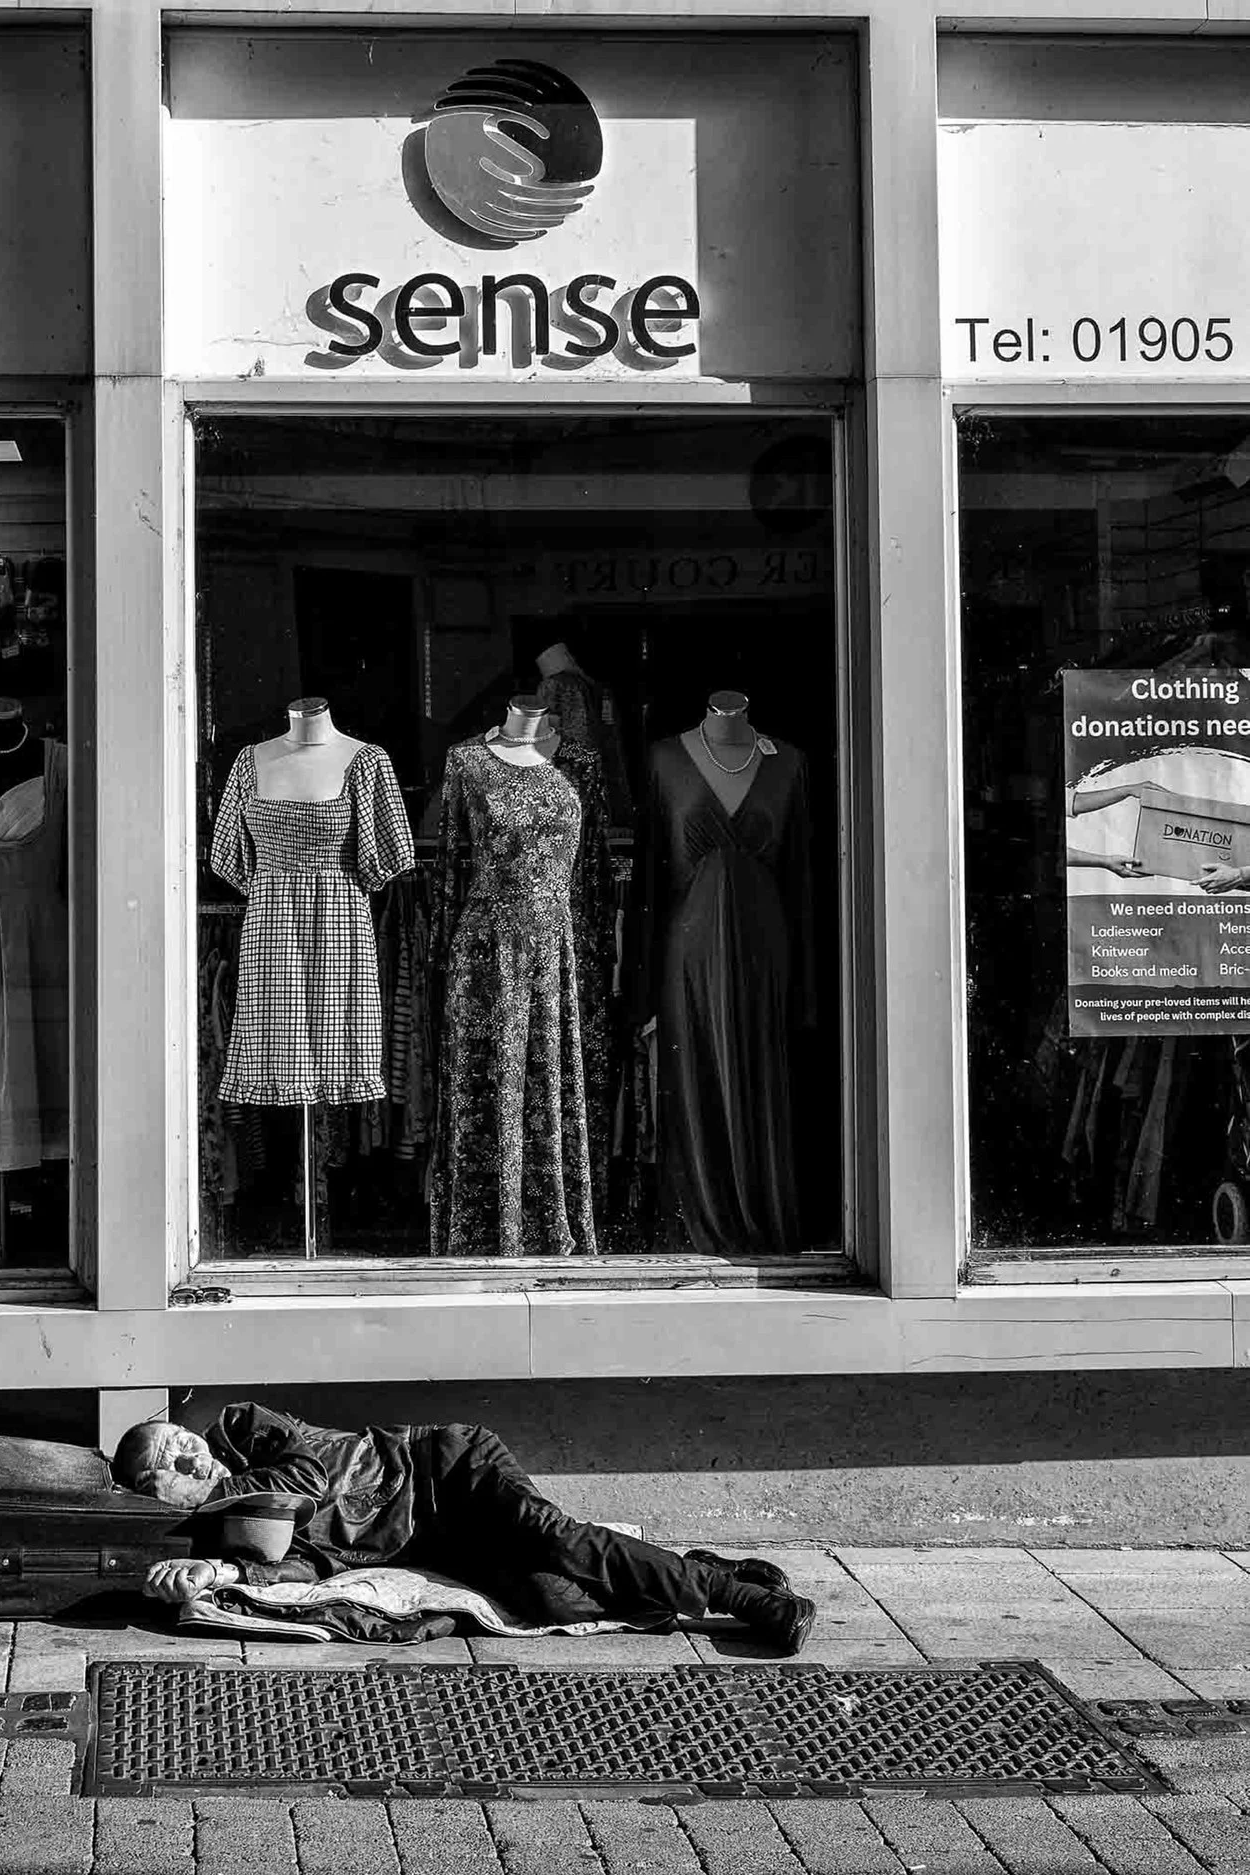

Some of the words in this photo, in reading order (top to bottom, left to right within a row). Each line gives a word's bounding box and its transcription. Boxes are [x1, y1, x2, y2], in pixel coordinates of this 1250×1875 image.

[327, 272, 700, 357] sense
[955, 318, 1049, 362] Tel:
[1072, 316, 1234, 362] 01905
[1131, 677, 1240, 704] Clothing
[1071, 715, 1199, 737] donations
[1207, 718, 1250, 736] nee
[1110, 903, 1133, 915] We
[1137, 902, 1173, 915] need
[1177, 901, 1250, 915] donations
[1091, 925, 1164, 937] Ladieswear
[1092, 945, 1149, 957] Knitwear
[1092, 965, 1128, 977] Books
[1132, 965, 1156, 977] and
[1160, 964, 1198, 976] media
[1075, 998, 1119, 1009] Donating
[1120, 1000, 1142, 1009] your
[1145, 997, 1191, 1008] pre-loved
[1193, 997, 1220, 1006] items
[1221, 997, 1239, 1006] will
[1100, 1012, 1123, 1021] lives
[1125, 1011, 1136, 1021] of
[1137, 1012, 1170, 1022] people
[1172, 1011, 1193, 1020] with
[1195, 1011, 1236, 1021] complex
